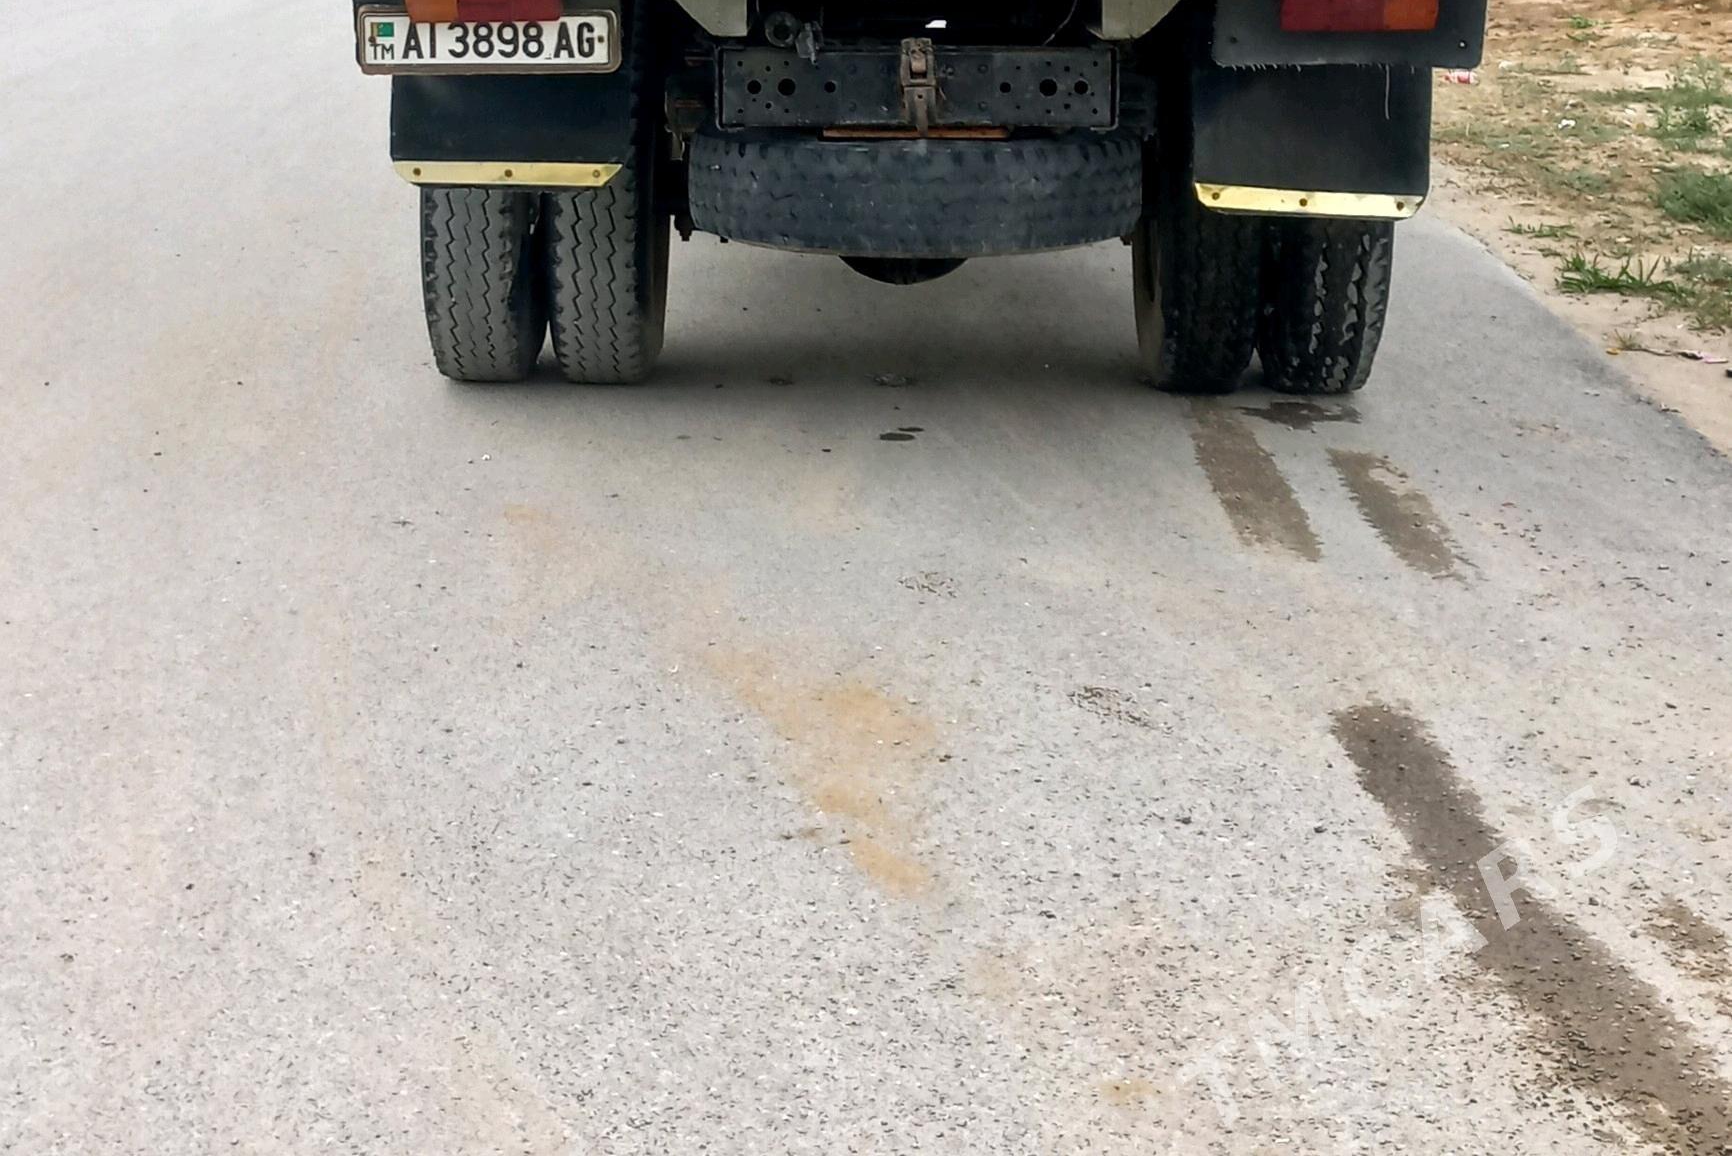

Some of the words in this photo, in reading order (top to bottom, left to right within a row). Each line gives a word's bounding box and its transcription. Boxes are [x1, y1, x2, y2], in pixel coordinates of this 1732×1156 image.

[371, 43, 395, 61] TM
[402, 22, 437, 60] AI
[447, 21, 544, 59] 3898
[553, 22, 595, 59] AG
